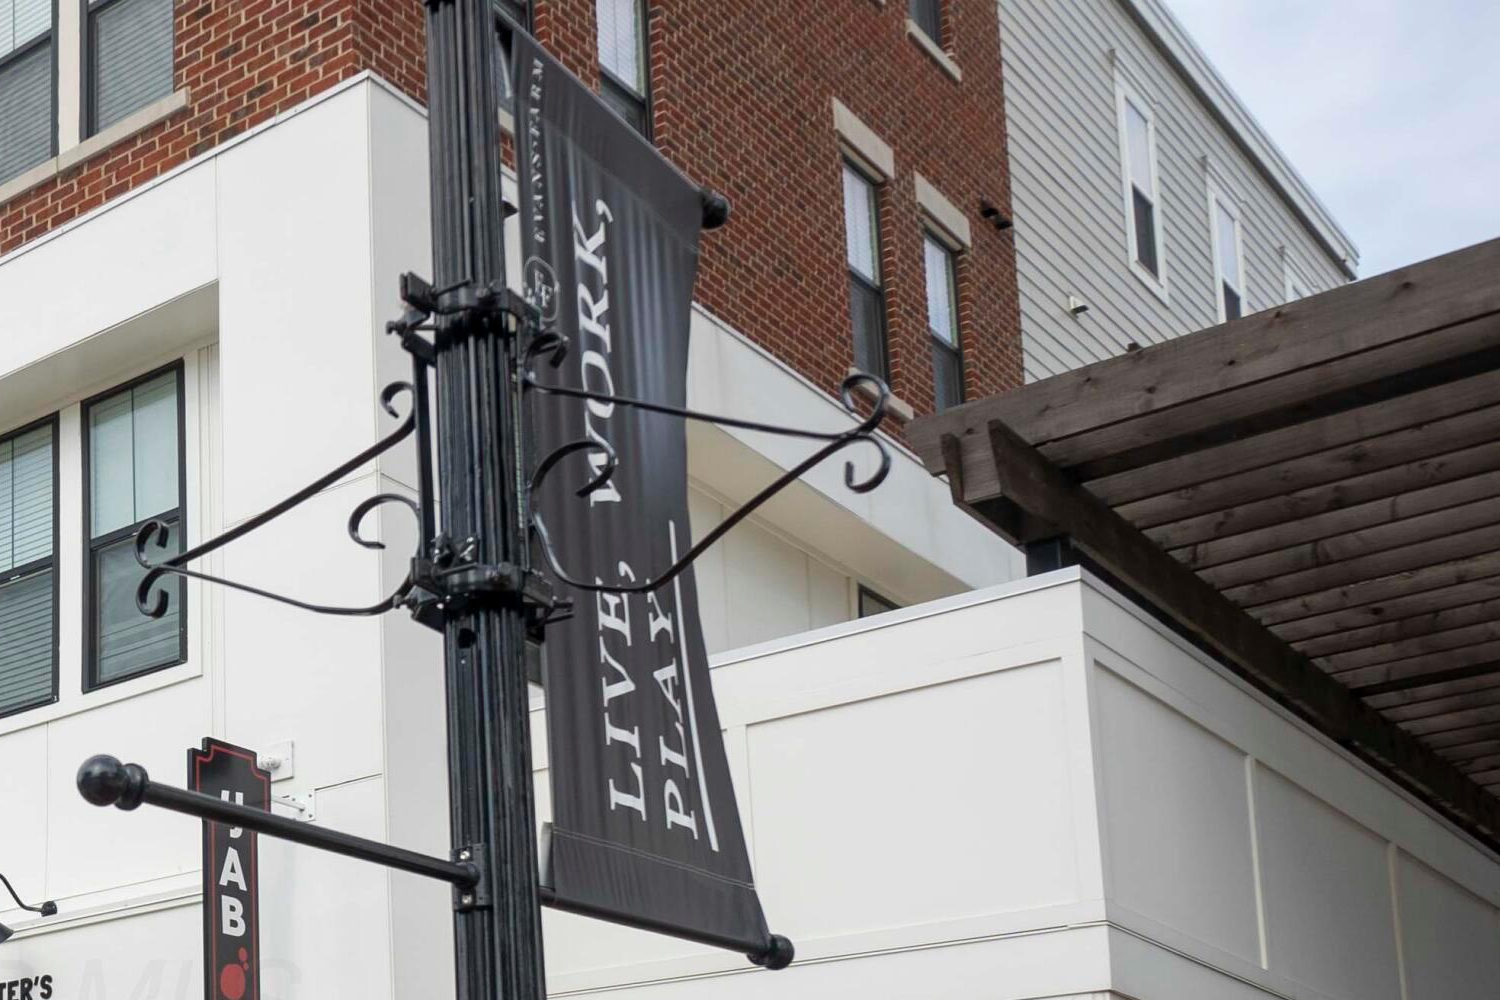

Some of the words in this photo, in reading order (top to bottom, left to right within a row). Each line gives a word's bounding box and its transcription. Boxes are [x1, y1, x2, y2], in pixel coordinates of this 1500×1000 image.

[572, 199, 622, 507] WORK,
[595, 560, 647, 822] LIVE,
[646, 578, 700, 841] PLAY
